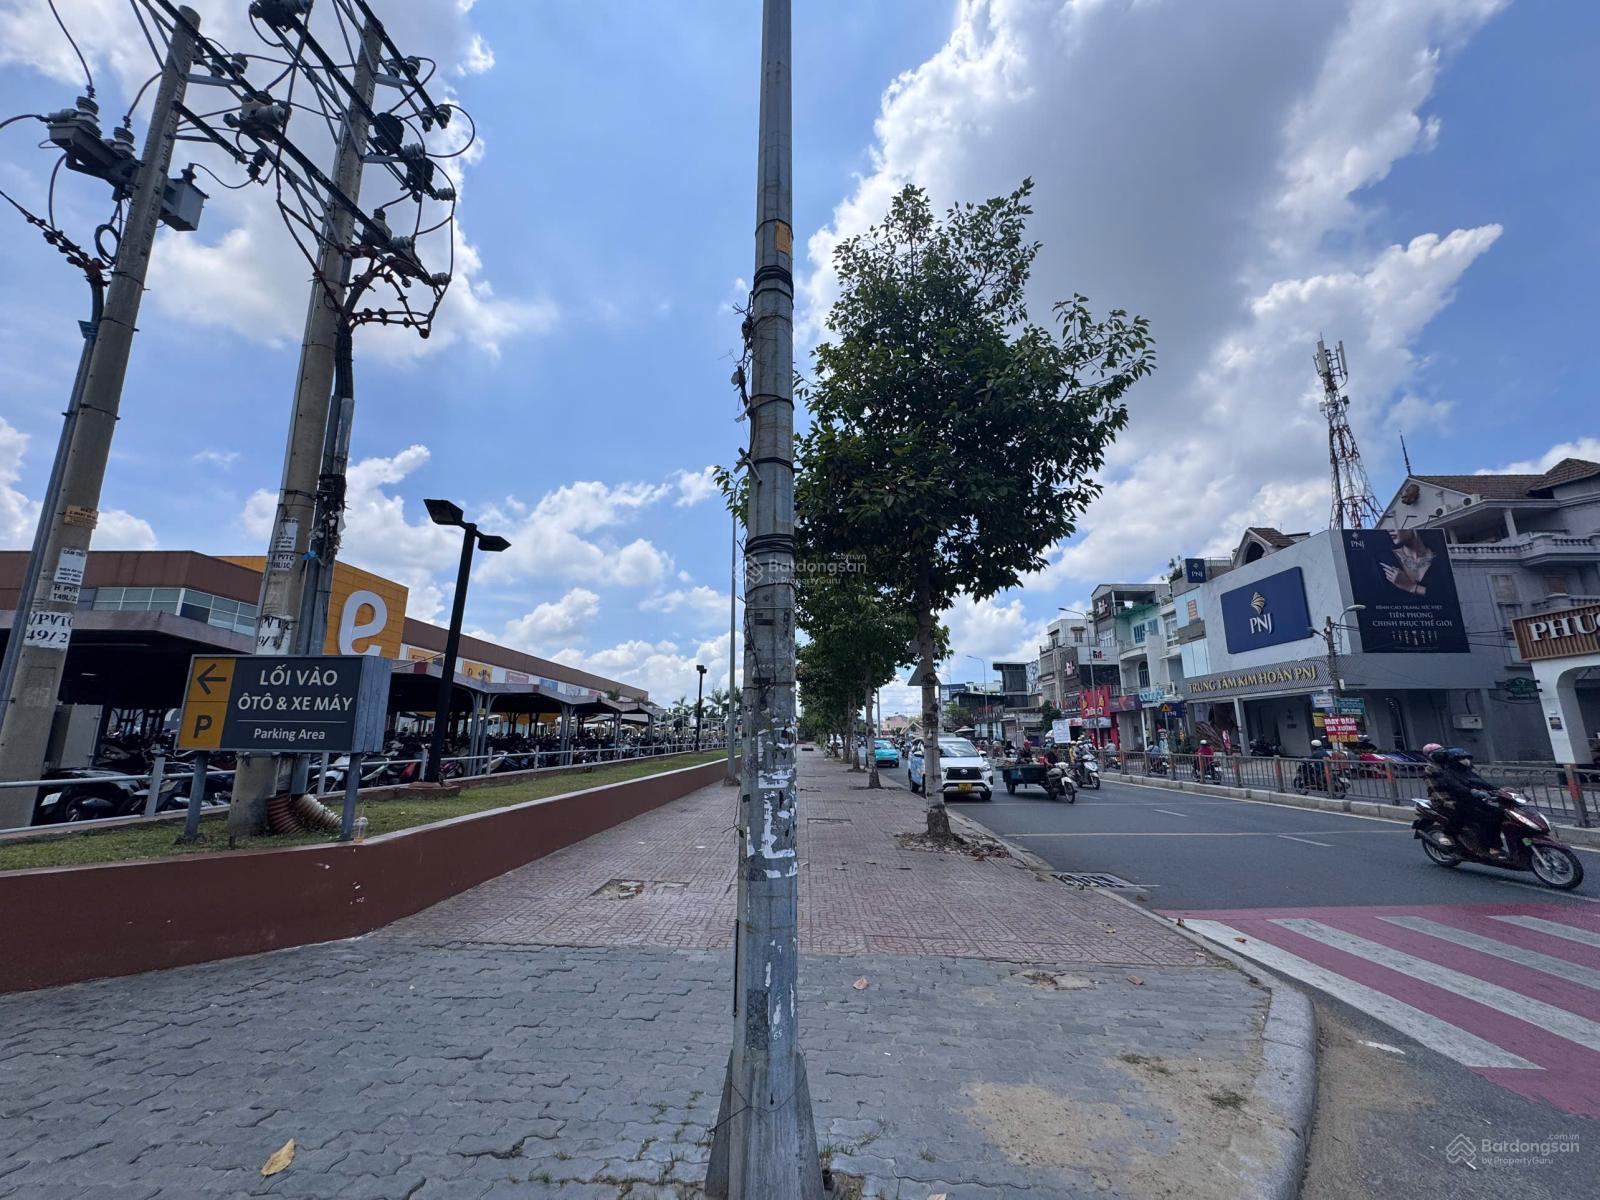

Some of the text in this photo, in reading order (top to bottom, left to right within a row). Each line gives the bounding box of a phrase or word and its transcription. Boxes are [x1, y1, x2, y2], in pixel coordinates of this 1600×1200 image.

[1350, 540, 1365, 549] PNJ
[1191, 570, 1203, 578] PNJ
[1249, 613, 1273, 634] PNJ
[259, 664, 338, 686] LỐI VÀO
[1188, 665, 1317, 693] TRUNG TÂM KIM HOÀN PNJ
[237, 692, 353, 711] ÔTÔ & XE MÁY
[193, 715, 213, 739] P
[253, 728, 325, 741] Parking Area
